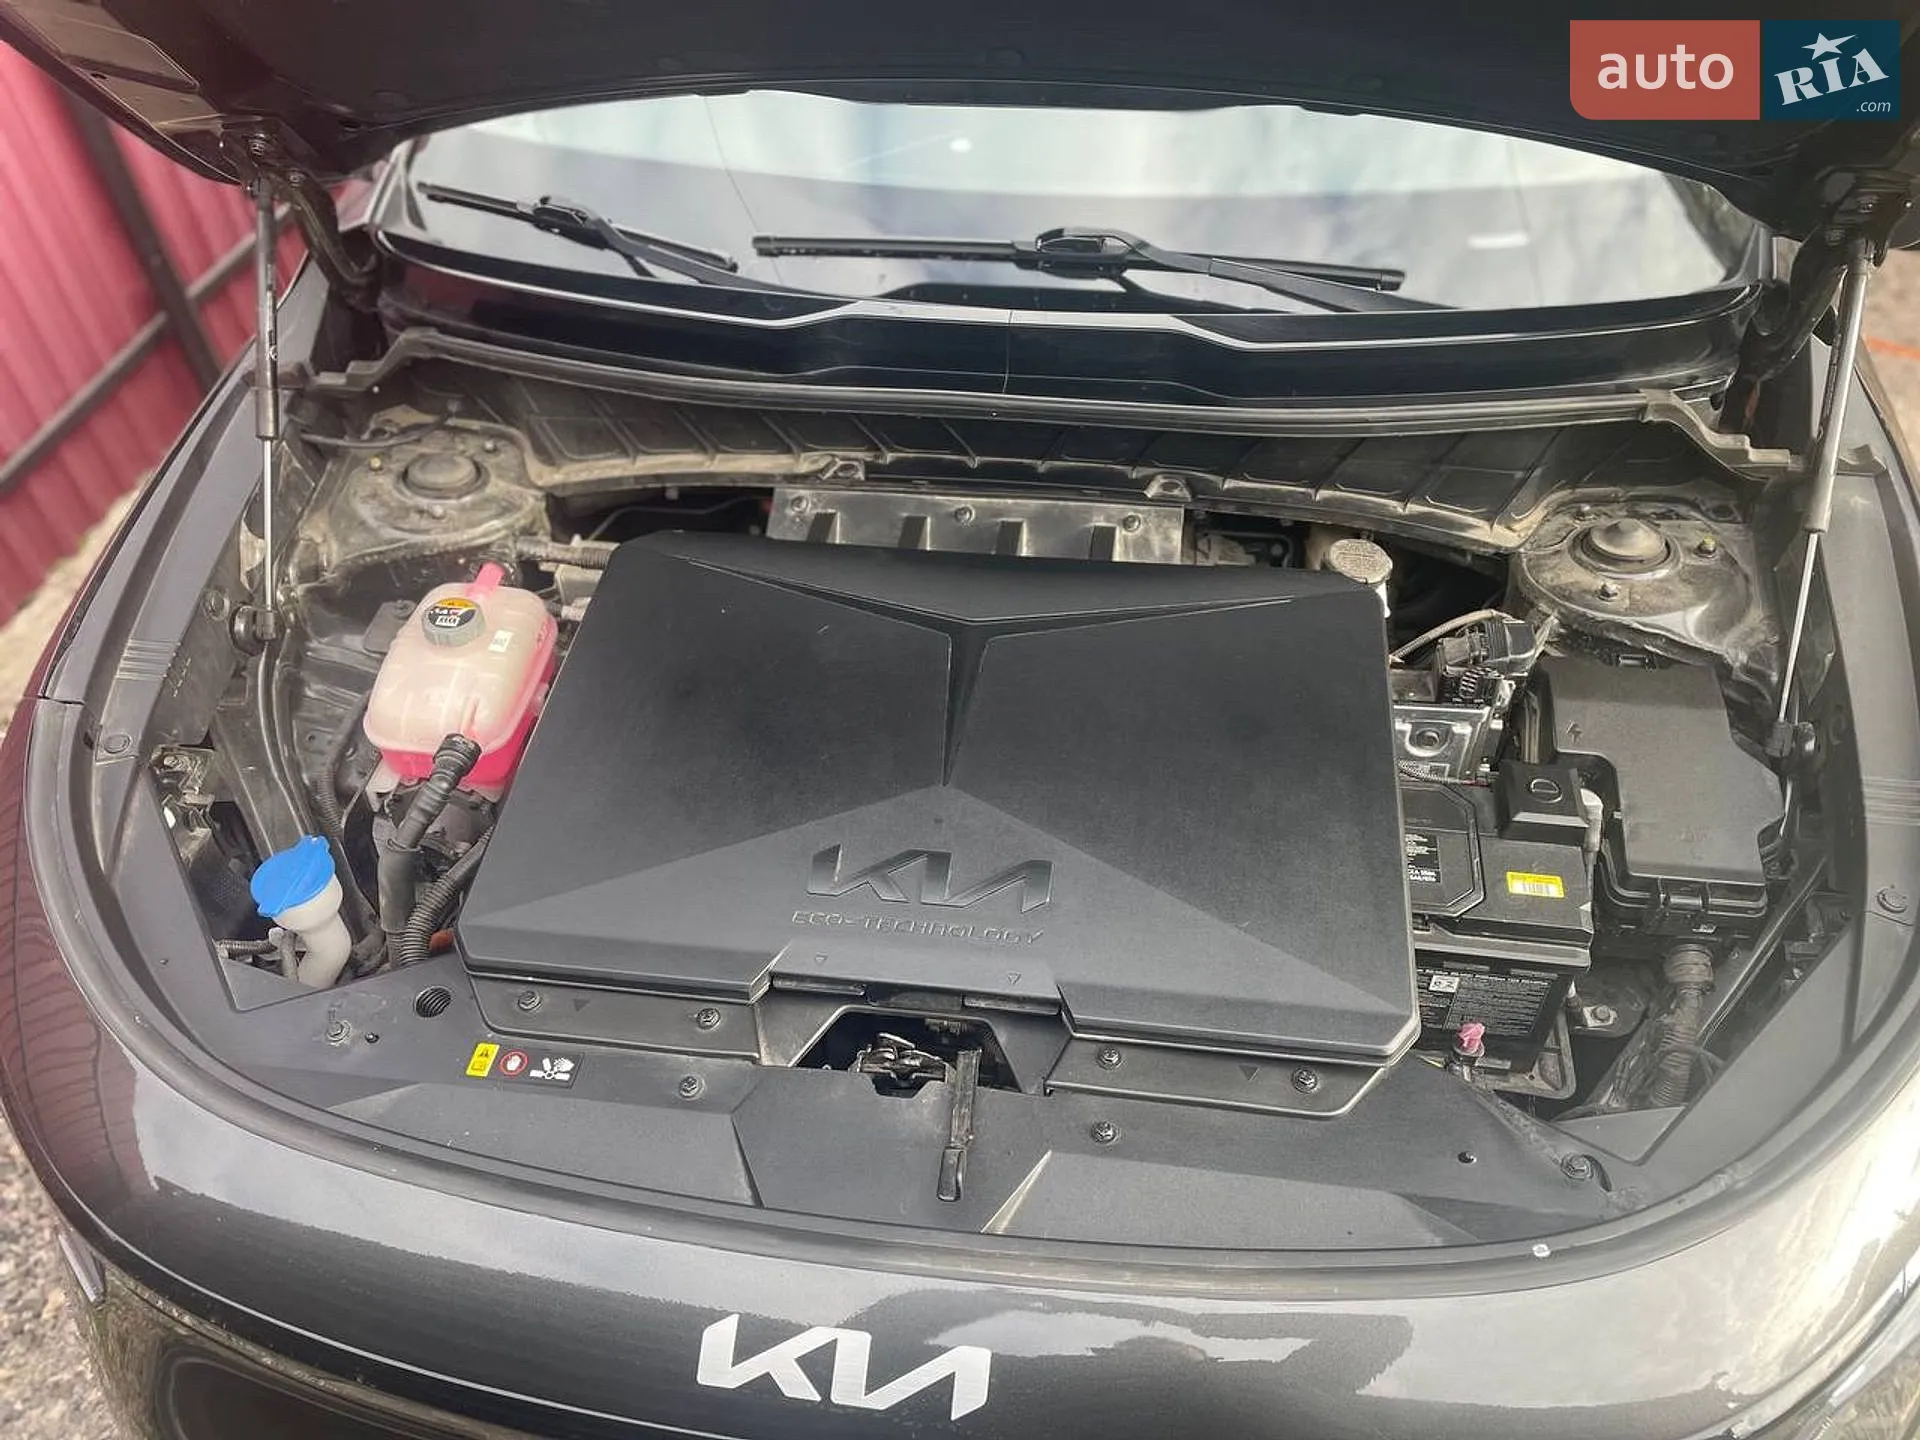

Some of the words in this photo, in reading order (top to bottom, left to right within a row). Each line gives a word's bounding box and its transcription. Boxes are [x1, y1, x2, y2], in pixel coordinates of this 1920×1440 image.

[807, 844, 1054, 914] KIA
[792, 910, 1044, 945] ECO-TECHNOLOGY
[697, 1313, 992, 1421] KIA
